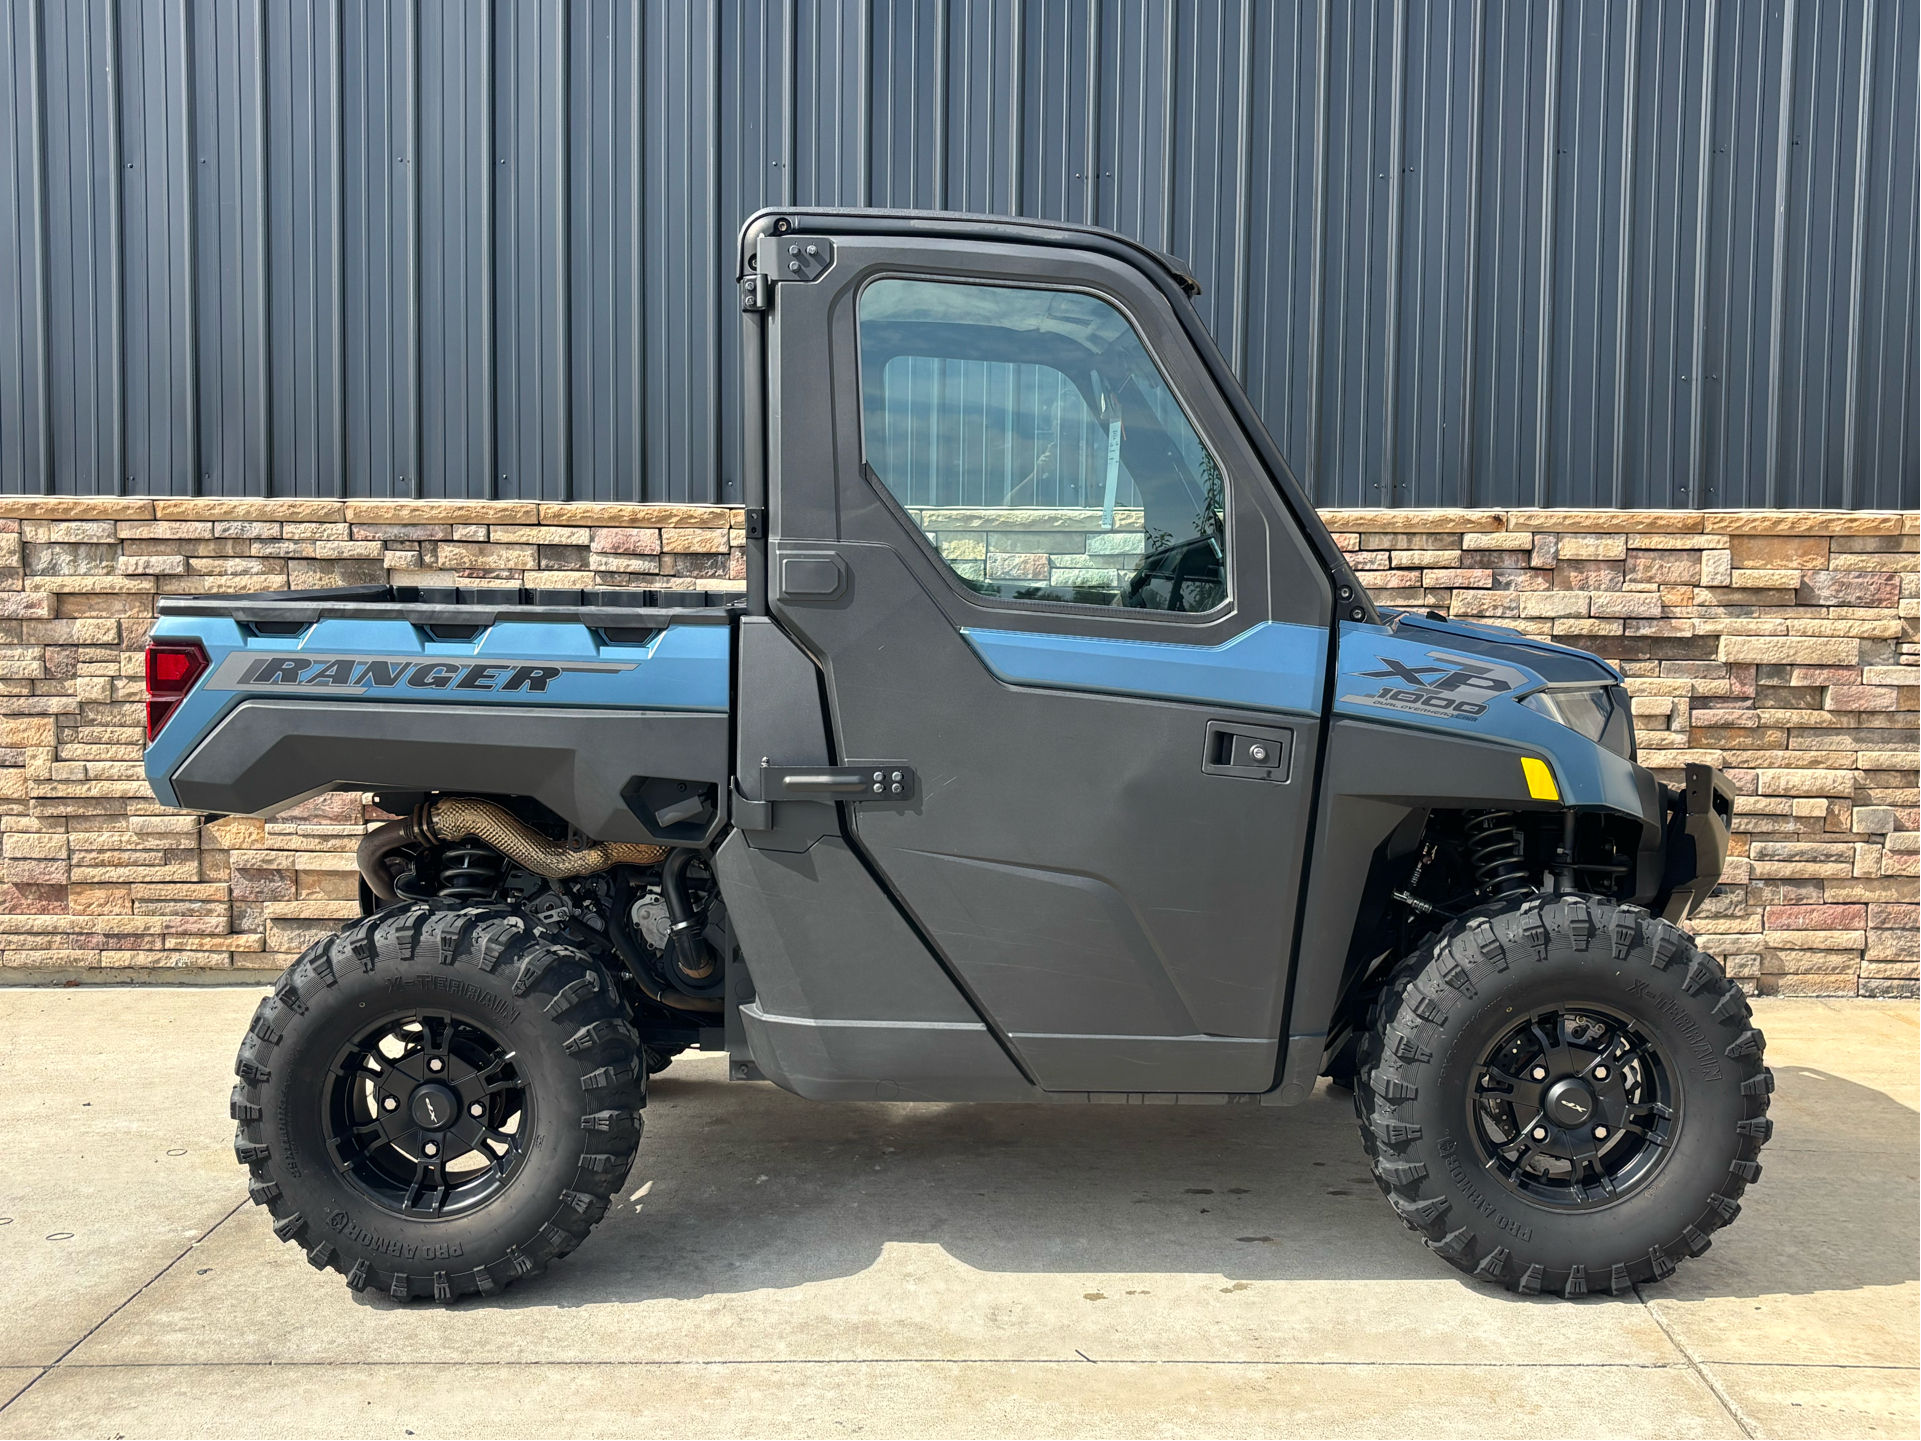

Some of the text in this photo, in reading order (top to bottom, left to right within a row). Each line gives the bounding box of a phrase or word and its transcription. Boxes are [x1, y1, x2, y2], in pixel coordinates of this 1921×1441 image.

[248, 657, 562, 693] RANGER
[1348, 655, 1514, 693] XP
[1373, 699, 1399, 709] DUAL
[1375, 686, 1488, 716] 1000
[385, 973, 521, 1024] X-TERRAIN
[1625, 978, 1723, 1082] X-TERRAIN
[1445, 1154, 1533, 1243] PRO ARMOR
[344, 1223, 464, 1260] PRO ARMOR
